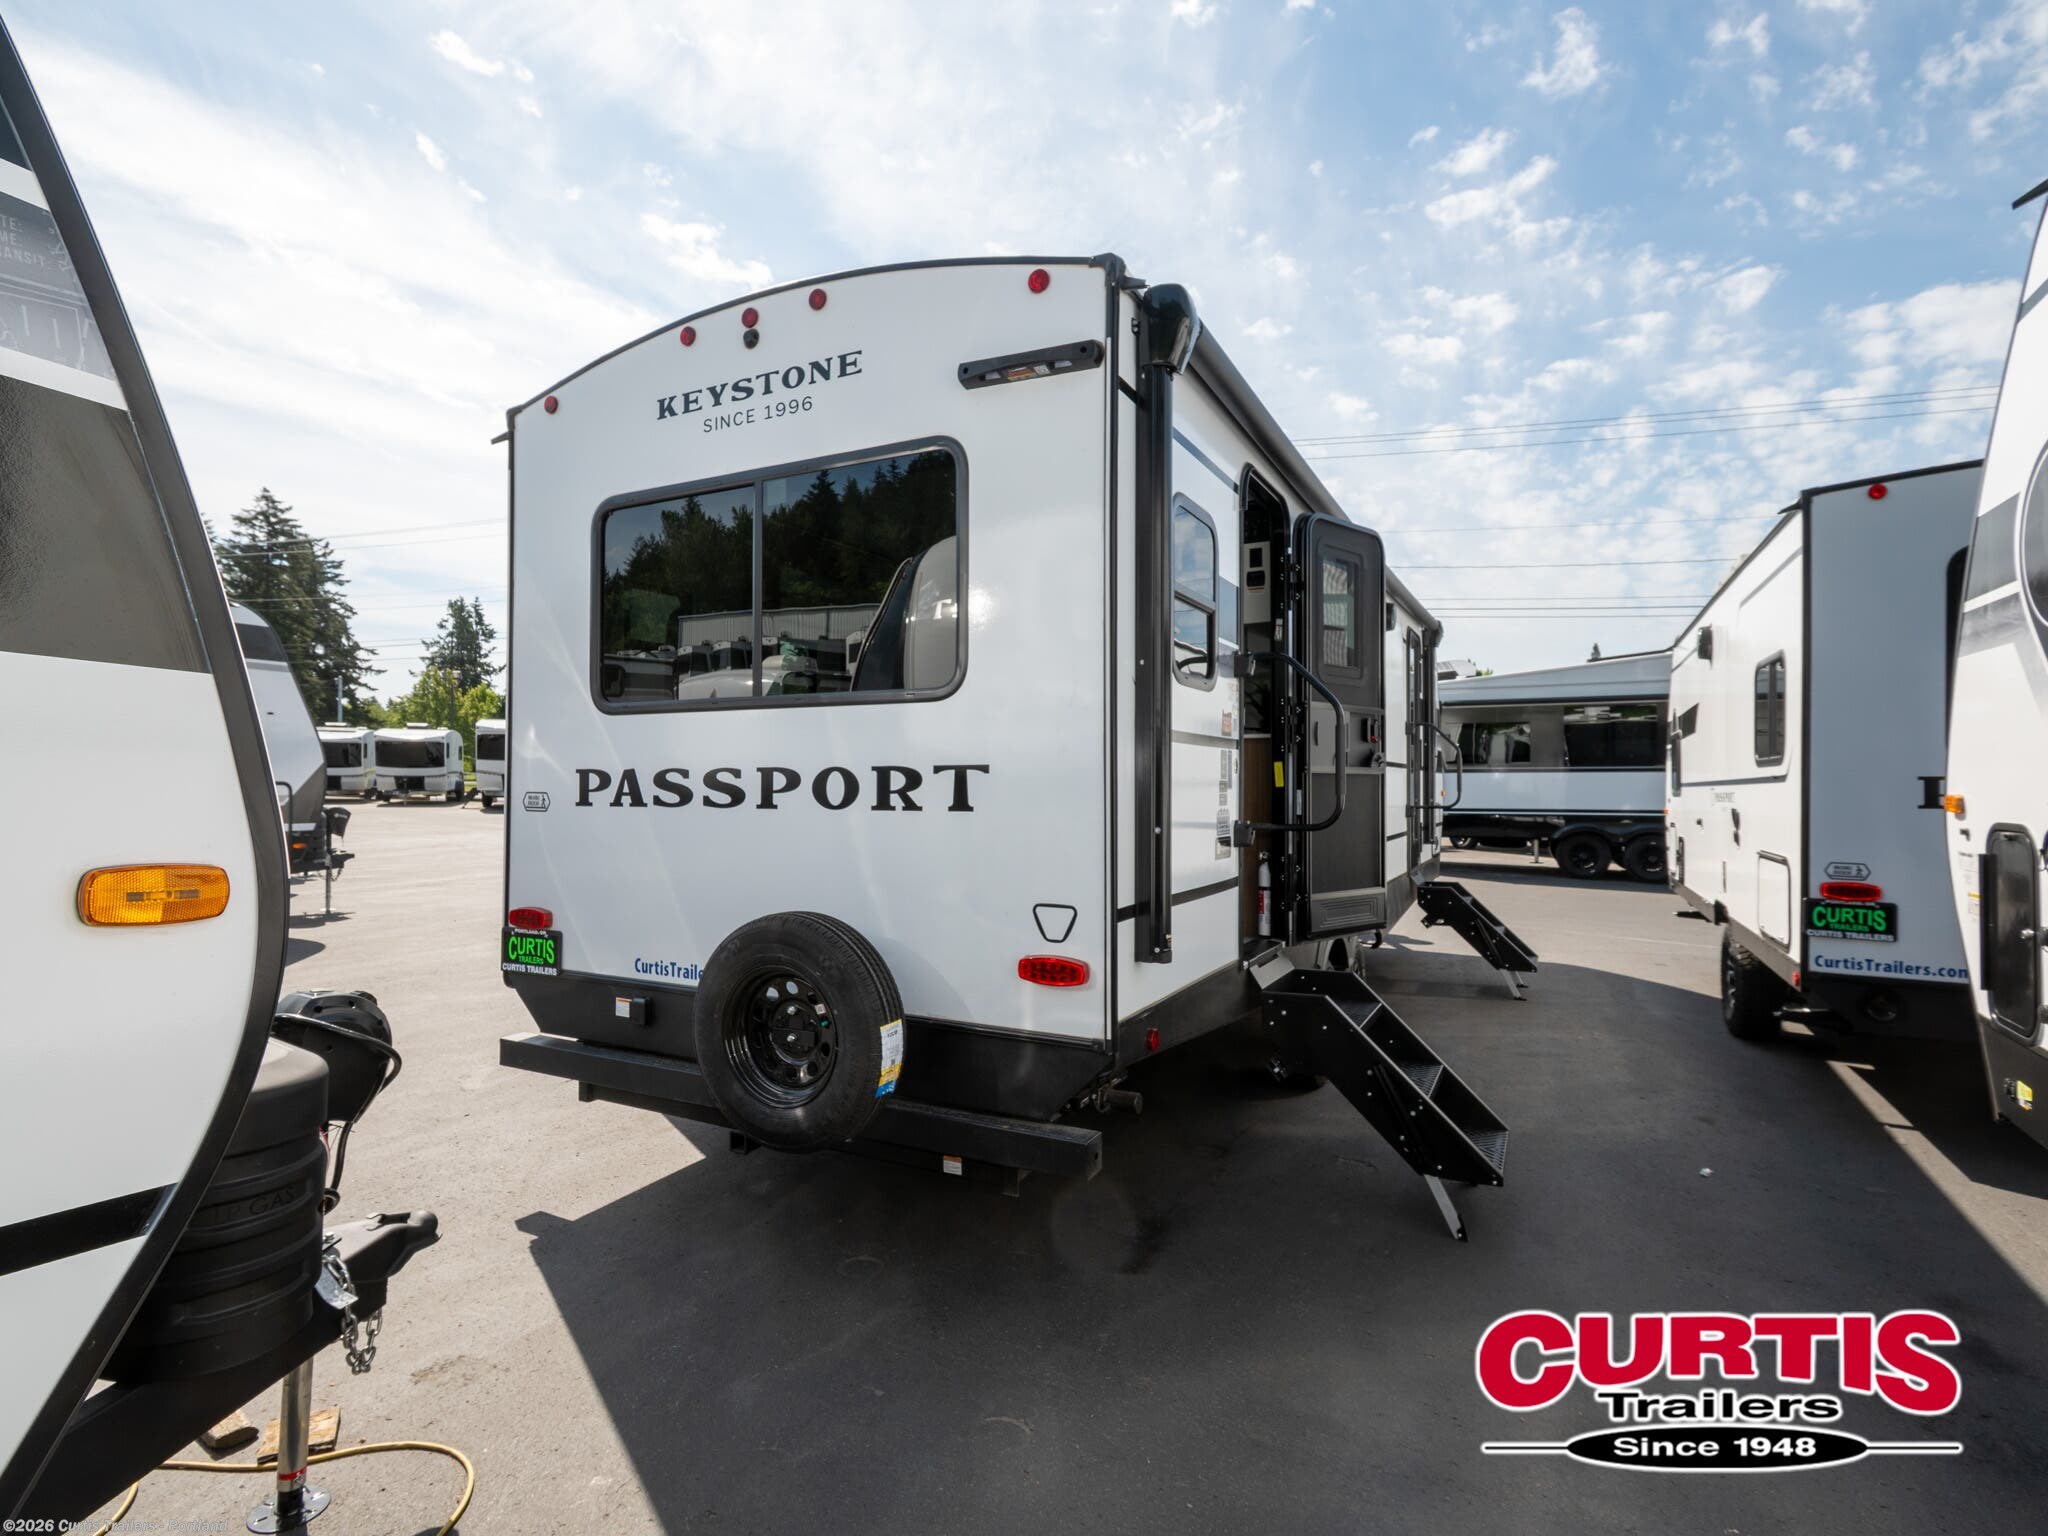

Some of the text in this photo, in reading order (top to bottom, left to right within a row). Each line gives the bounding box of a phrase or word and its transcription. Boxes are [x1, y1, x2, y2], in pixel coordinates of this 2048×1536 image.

[657, 350, 863, 420] KEYSTONE
[703, 396, 813, 433] SINCE 1996
[575, 764, 990, 812] PASSPORT
[1812, 906, 1887, 931] CURTIS
[1807, 928, 1894, 942] CURTIS TRAILERS
[508, 936, 555, 965] CURTIS
[502, 962, 558, 976] CURTIS TRAILERS
